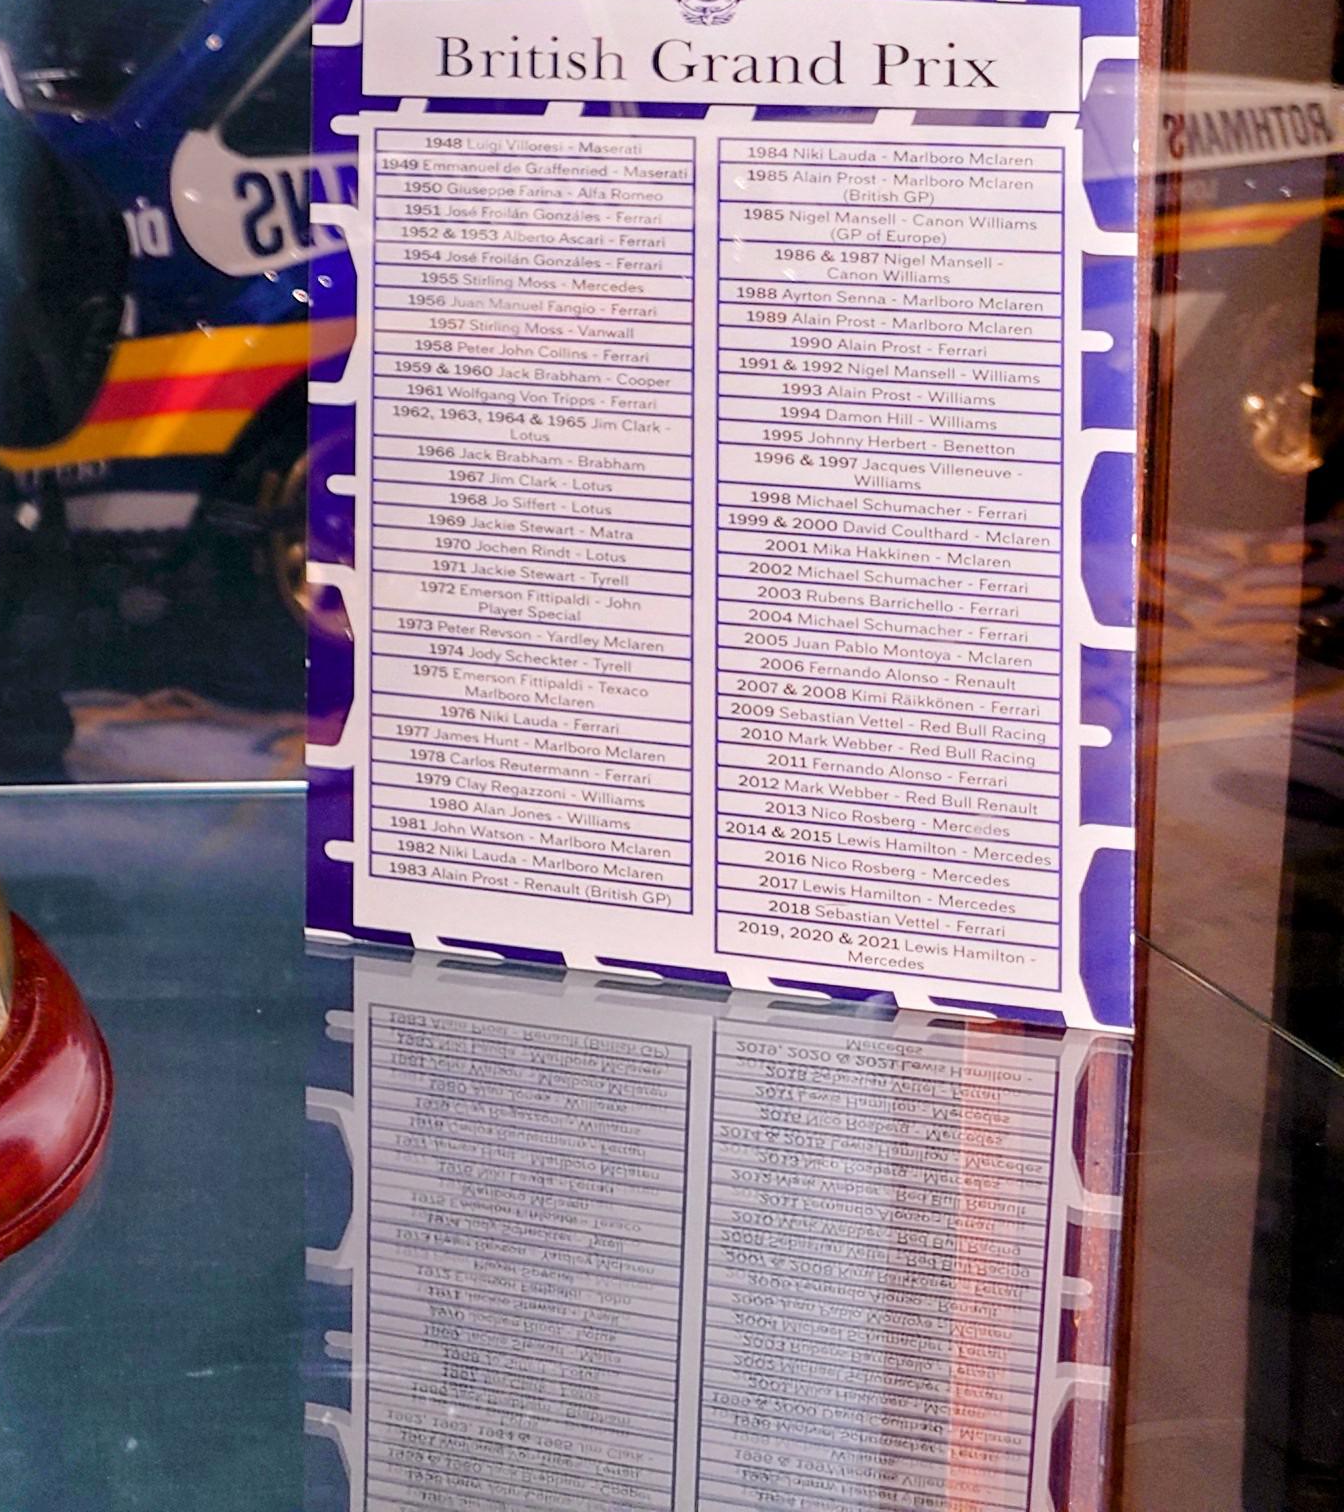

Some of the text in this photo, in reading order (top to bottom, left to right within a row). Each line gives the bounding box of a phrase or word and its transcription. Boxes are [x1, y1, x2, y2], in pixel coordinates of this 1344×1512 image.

[435, 34, 999, 90] British Grand Prix
[748, 146, 788, 159] 1984
[793, 148, 823, 160] Niki
[828, 148, 876, 162] Lauda
[893, 150, 965, 164] Marlboro
[415, 339, 649, 363] 1958 Peter John Collins Ferrari
[751, 490, 1027, 521] 1998 Michael Schumacher Ferrari
[736, 678, 779, 694] 2007
[782, 682, 798, 696] &
[801, 684, 847, 701] 2008
[852, 688, 887, 703] Kimi
[991, 700, 1040, 717] Ferrari
[441, 705, 619, 735] 1976 Niki Lauda Ferrari
[740, 726, 1036, 768] 2010 Mark Webber Red Bull Racing
[389, 861, 672, 908] 1983 Alain Prost Renault (British GP)
[758, 874, 1016, 914] 2017 Lewis Hamilton Mercedes
[789, 926, 834, 943] 2020
[838, 931, 854, 945] &
[857, 934, 900, 951] 2021
[904, 939, 949, 956] Lewis
[953, 944, 1025, 964] Hamilton
[848, 949, 925, 970] Mercedes
